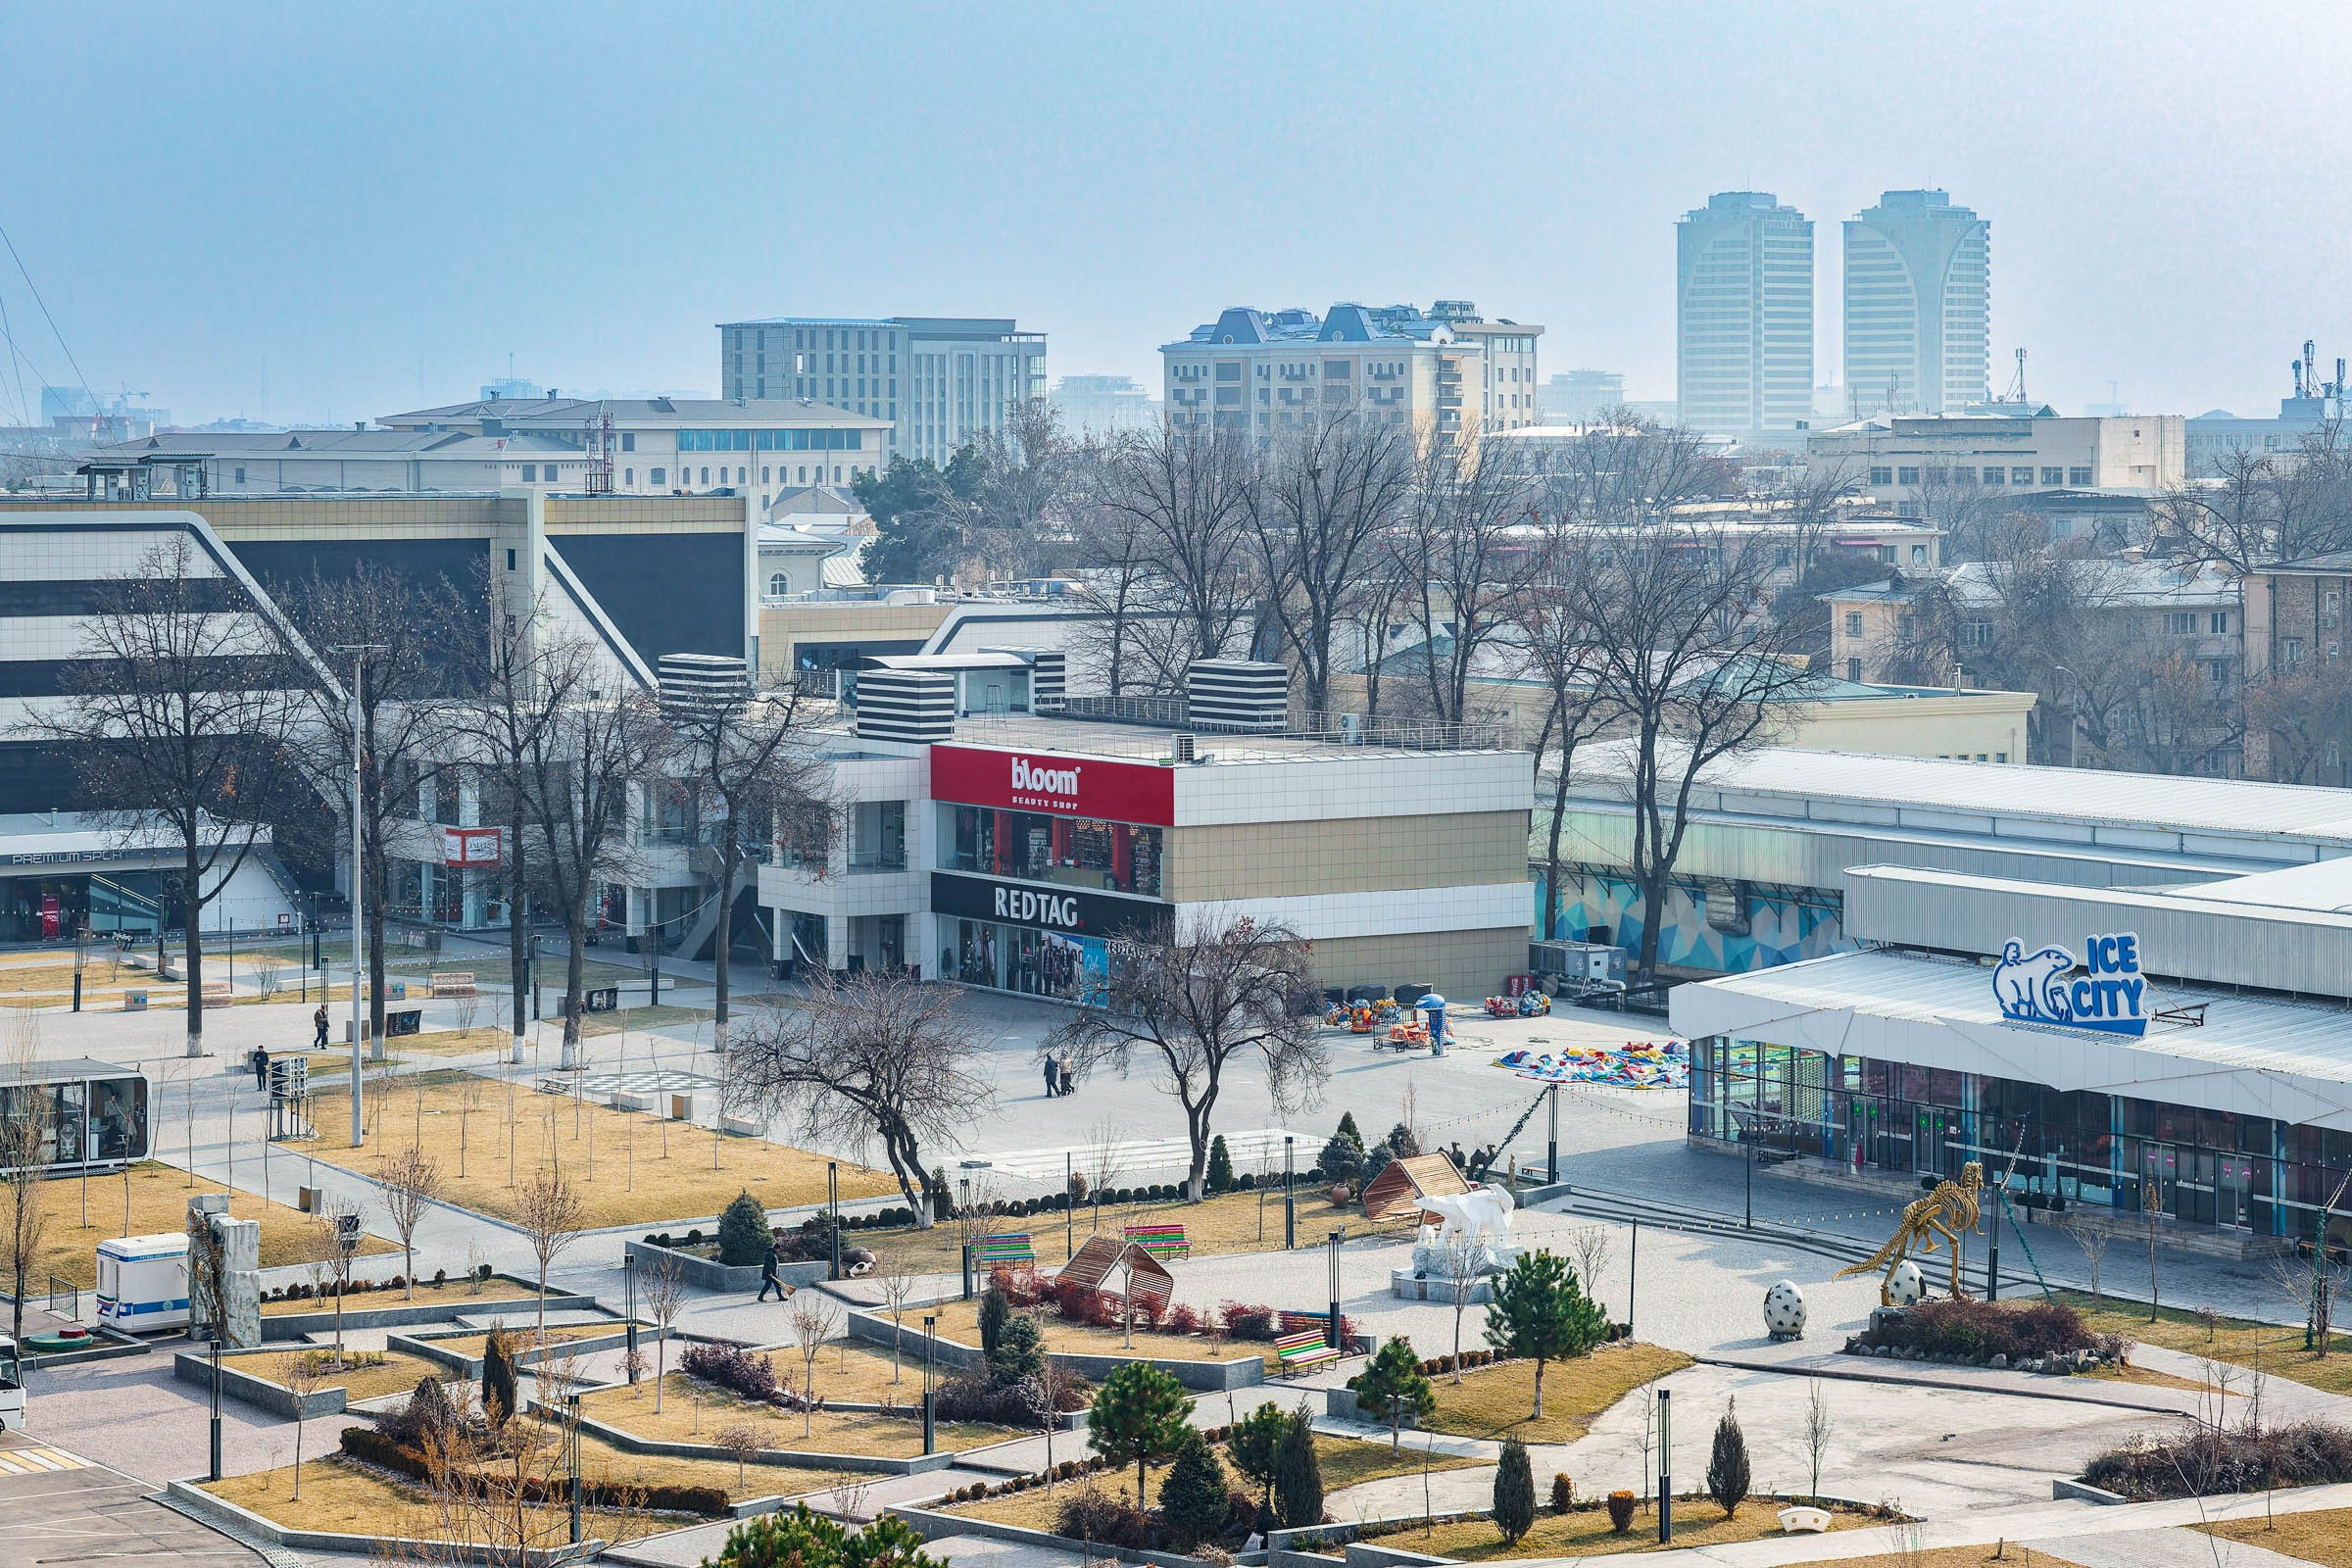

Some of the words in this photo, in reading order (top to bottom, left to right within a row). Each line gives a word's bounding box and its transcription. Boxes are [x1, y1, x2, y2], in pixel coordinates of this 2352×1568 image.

[1011, 757, 1078, 795] bloom
[1012, 796, 1049, 808] BEAUTY
[1053, 800, 1078, 810] SHOP
[13, 853, 79, 864] PREMIUM
[82, 850, 127, 861] SPORT
[995, 887, 1078, 927] REDTAG
[2086, 936, 2138, 973] ICE
[2071, 978, 2143, 1017] CITY
